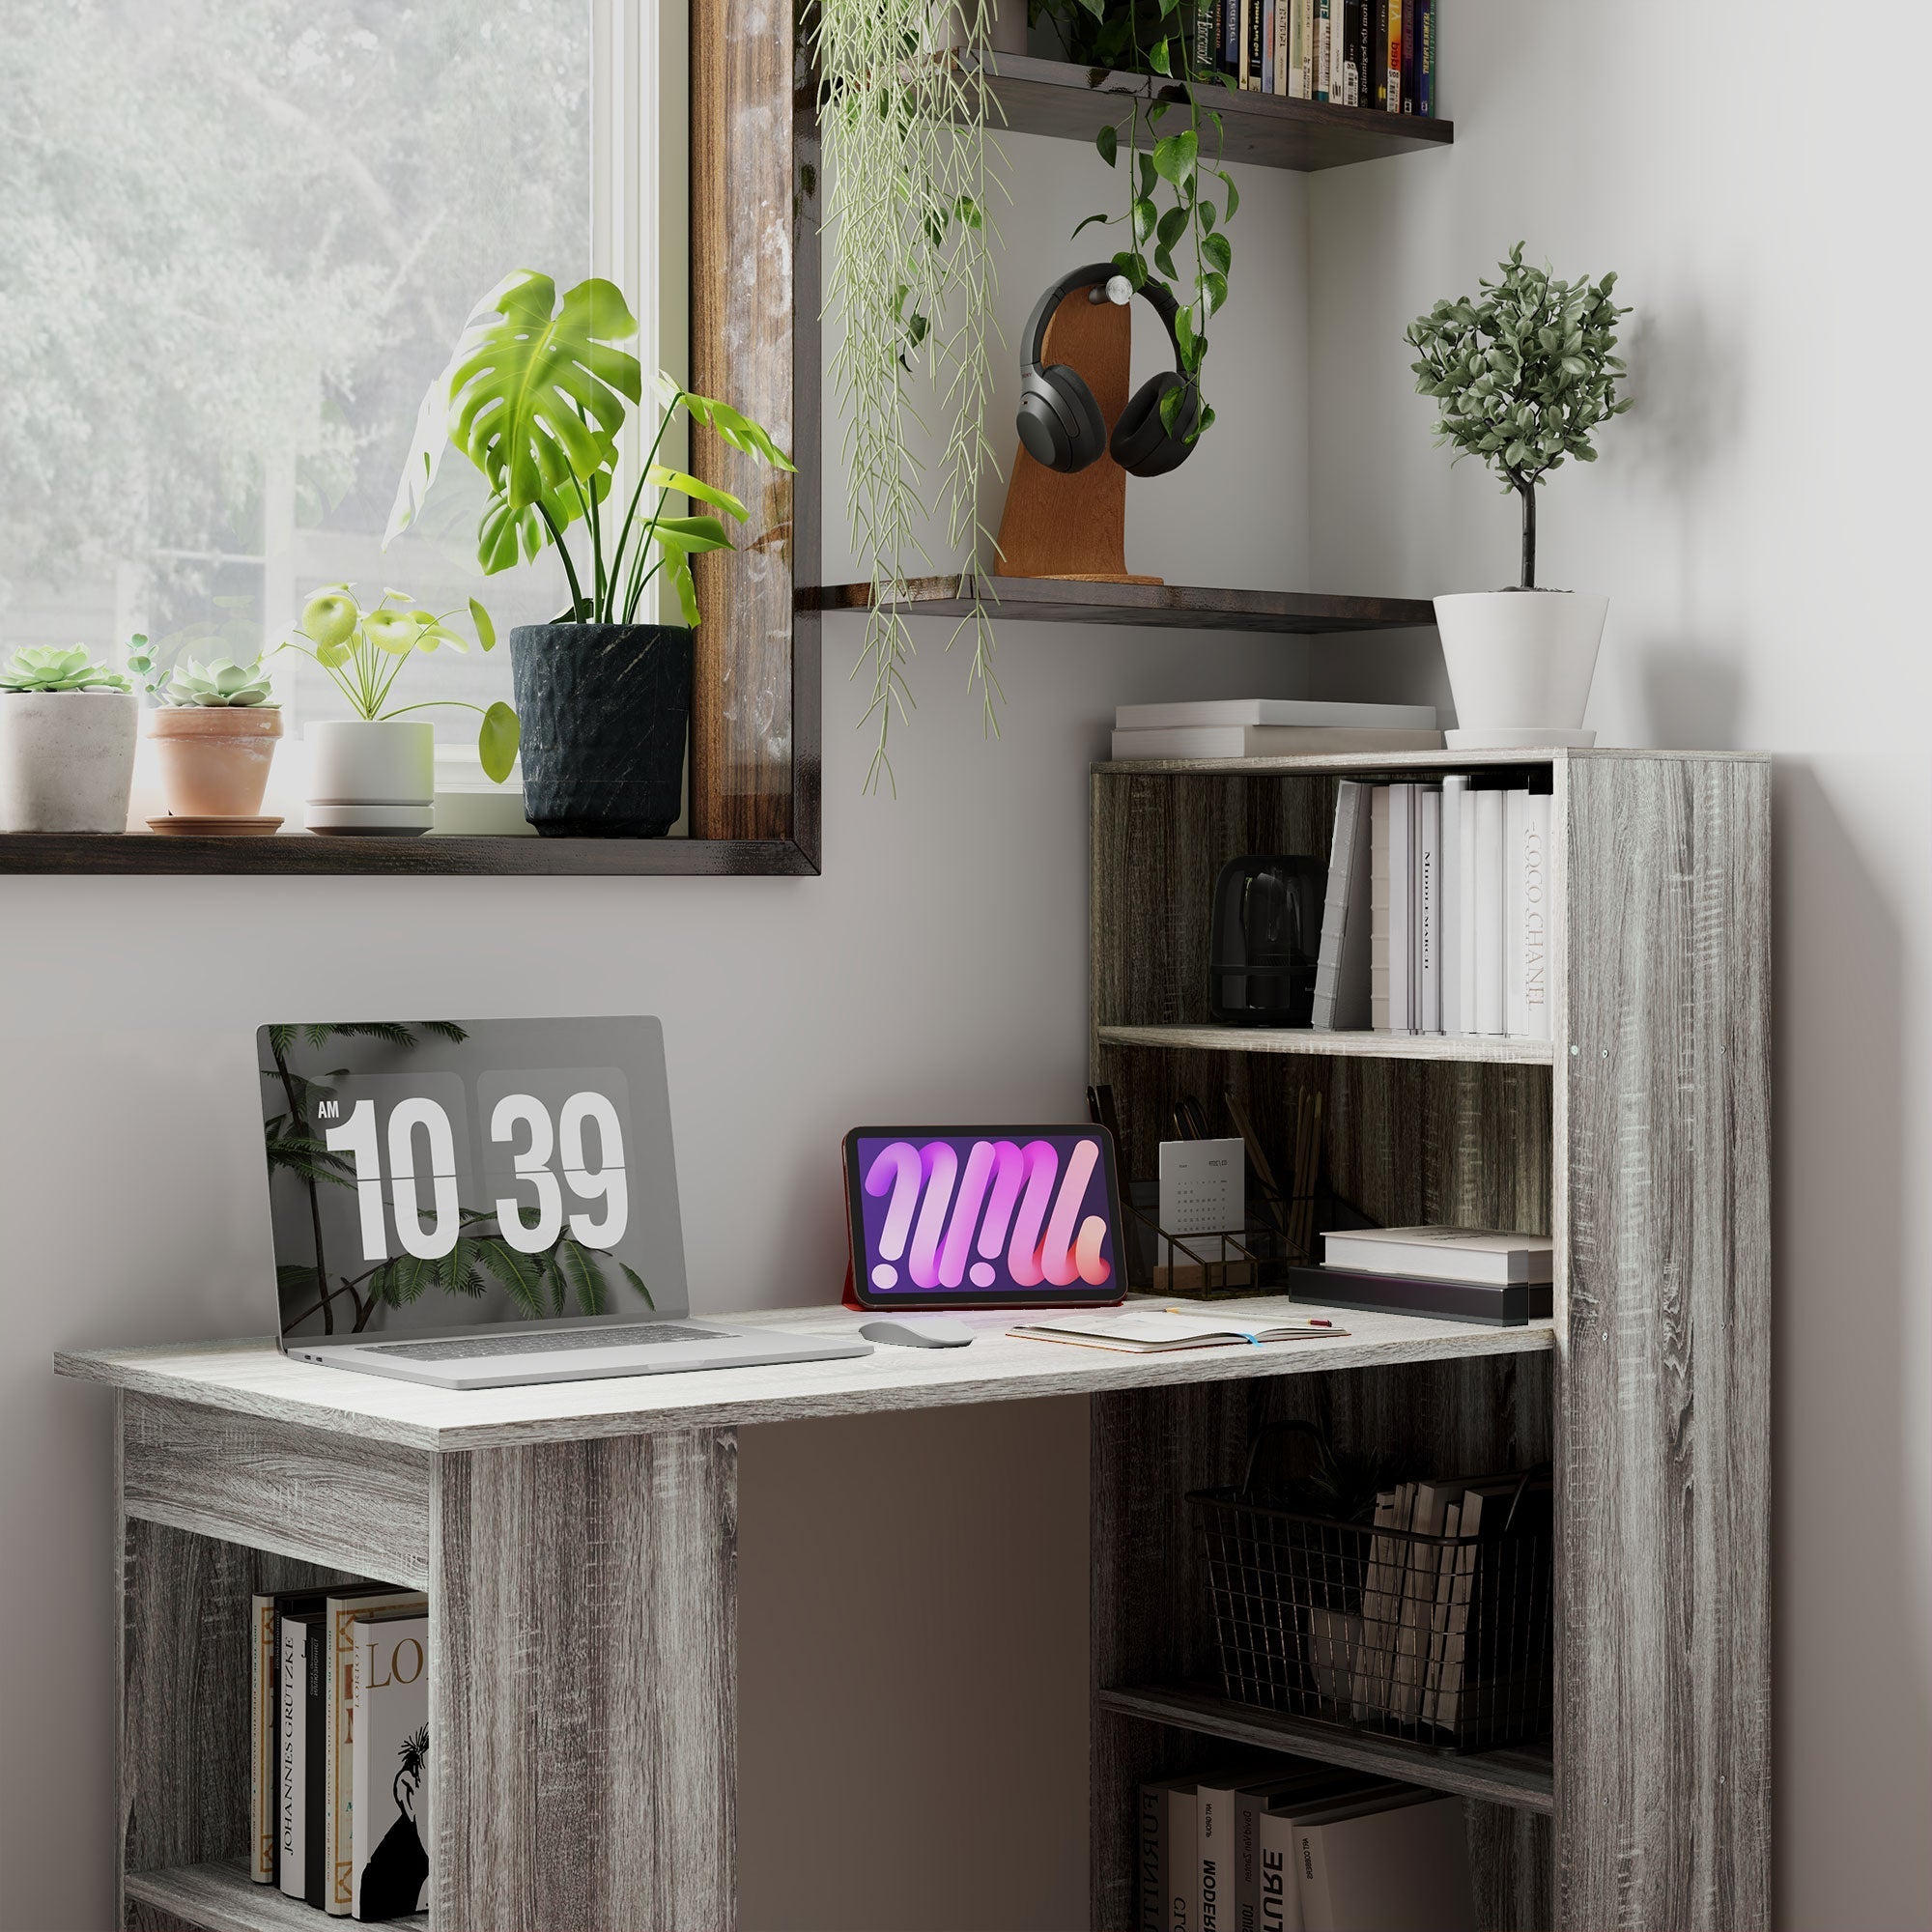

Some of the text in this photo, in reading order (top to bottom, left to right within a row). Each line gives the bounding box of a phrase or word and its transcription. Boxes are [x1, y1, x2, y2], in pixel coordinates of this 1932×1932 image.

[1524, 908, 1545, 1012] CHANEL
[318, 1100, 340, 1119] AM
[325, 1092, 629, 1262] 10 39
[365, 1636, 429, 1690] LO
[284, 1637, 294, 1856] JOHANNES GRÜTZKE
